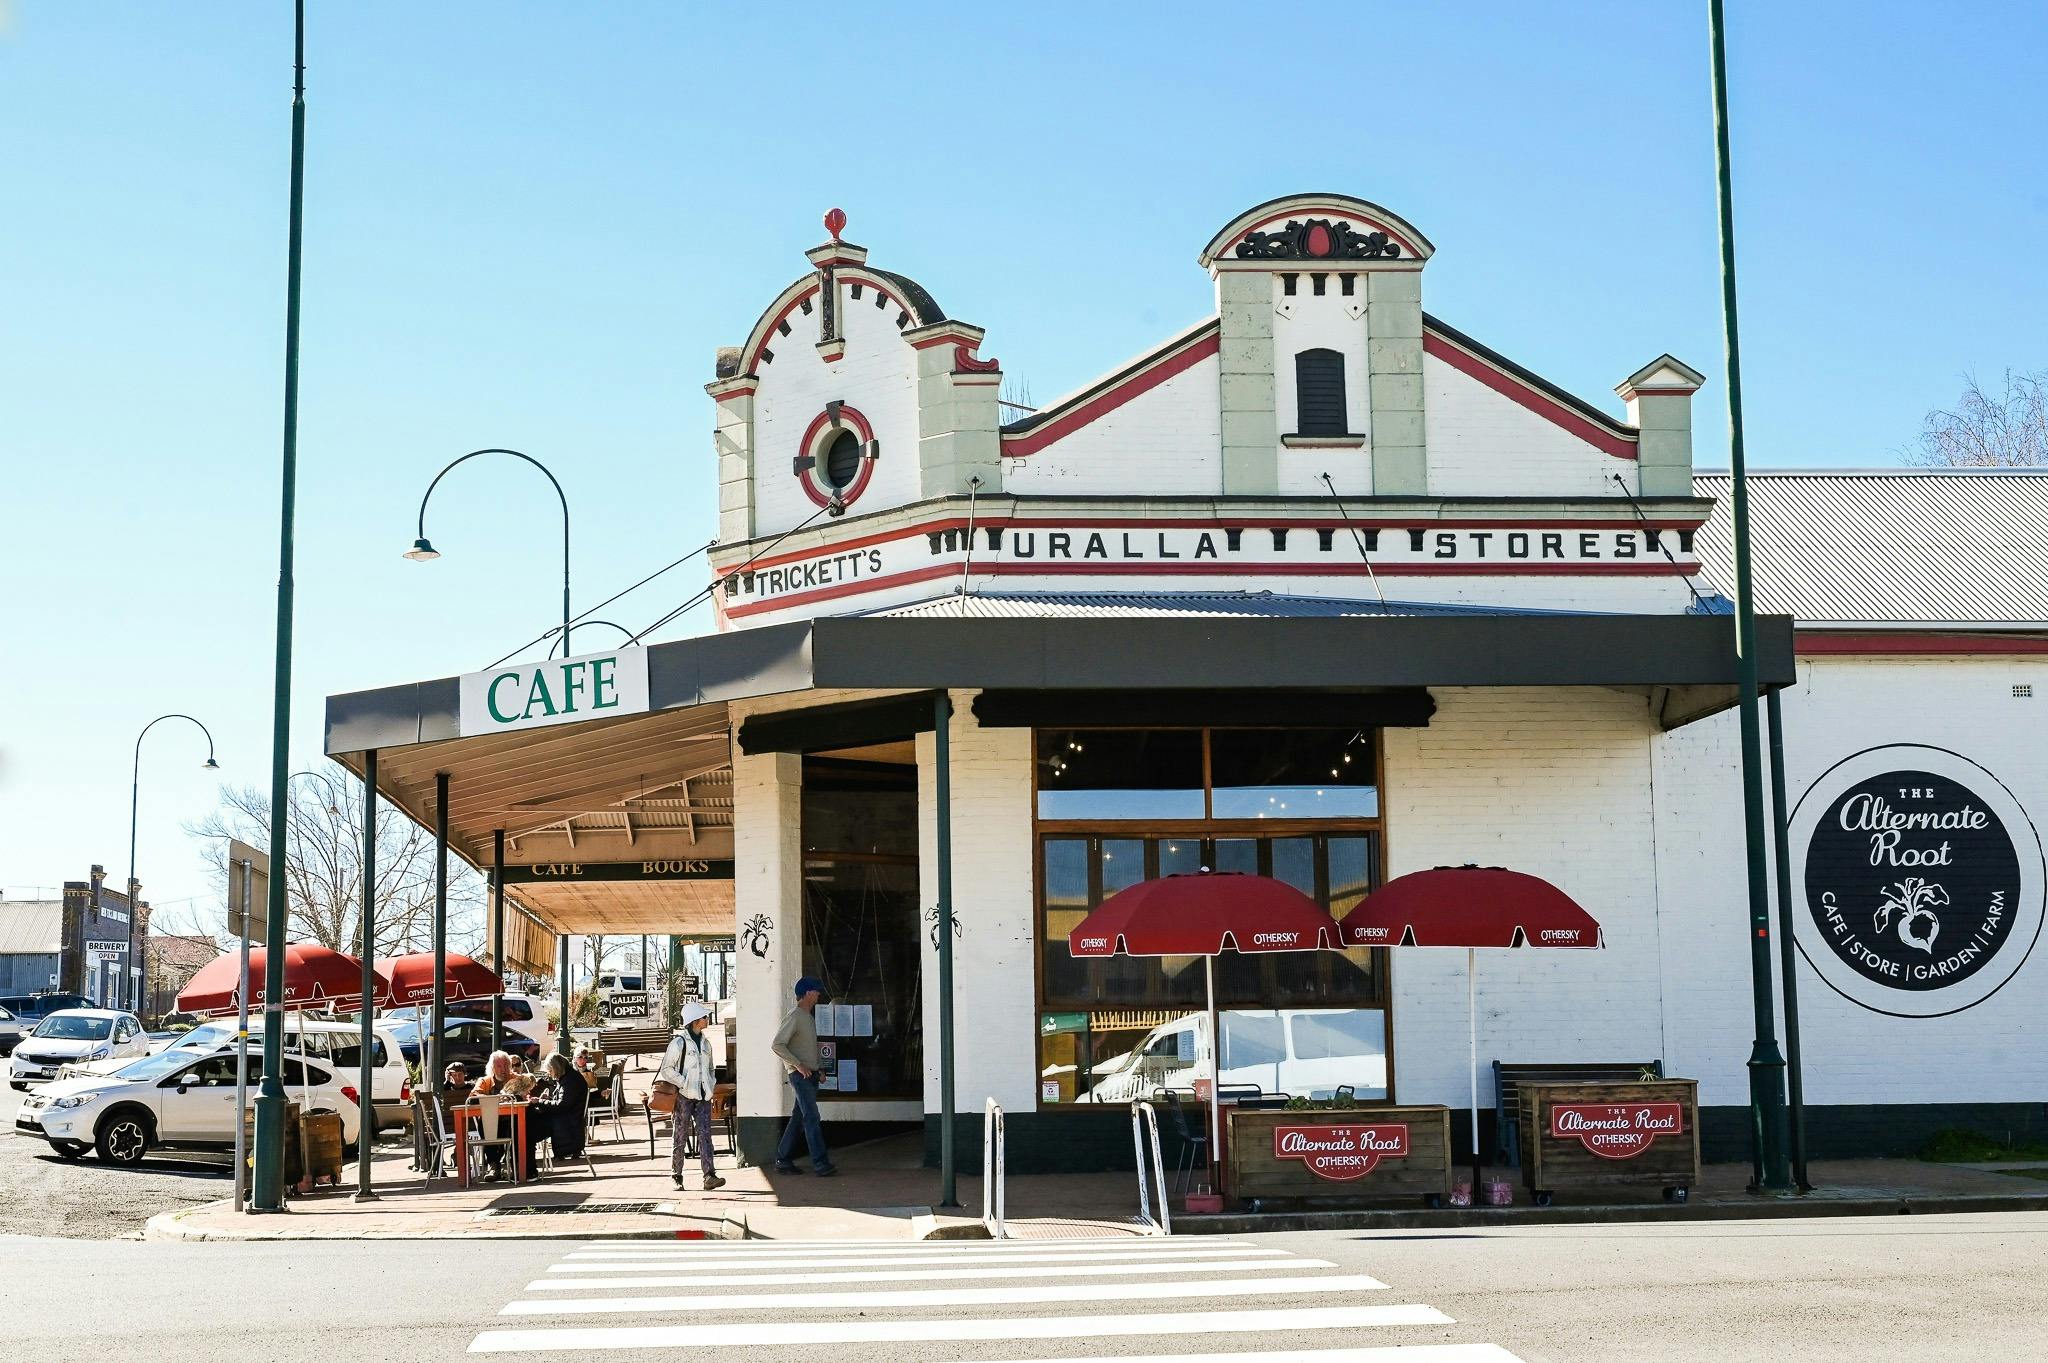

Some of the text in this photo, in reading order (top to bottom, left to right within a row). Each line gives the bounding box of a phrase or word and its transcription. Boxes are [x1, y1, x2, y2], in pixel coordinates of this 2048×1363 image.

[1014, 532, 1637, 559] URALLA STORES
[755, 549, 882, 596] TRICKETT'S
[487, 656, 619, 723] CAFE
[1899, 788, 1934, 799] THE
[1840, 793, 1989, 831] Alternate
[1870, 829, 1952, 867] Root
[531, 860, 709, 876] CAFE BOOKS
[1253, 932, 1300, 945] OTHERSKY
[1355, 927, 1389, 938] OTHERSKY
[1541, 929, 1580, 941] OTHERSKY
[1821, 891, 1848, 936] CAFE
[1849, 941, 1900, 977] STORE
[1913, 941, 1982, 980] GARDEN
[1981, 890, 2005, 936] FARM
[88, 942, 126, 950] BREWERY
[703, 944, 736, 952] GALL
[1080, 938, 1107, 949] OTHERSKY
[611, 995, 647, 1005] GALLERY
[614, 1005, 645, 1016] OPEN
[1558, 1109, 1675, 1131] Alternate Root
[1281, 1130, 1401, 1152] Alternate Root
[1592, 1133, 1644, 1146] OTHERSKY
[1315, 1155, 1368, 1168] OTHERSKY
